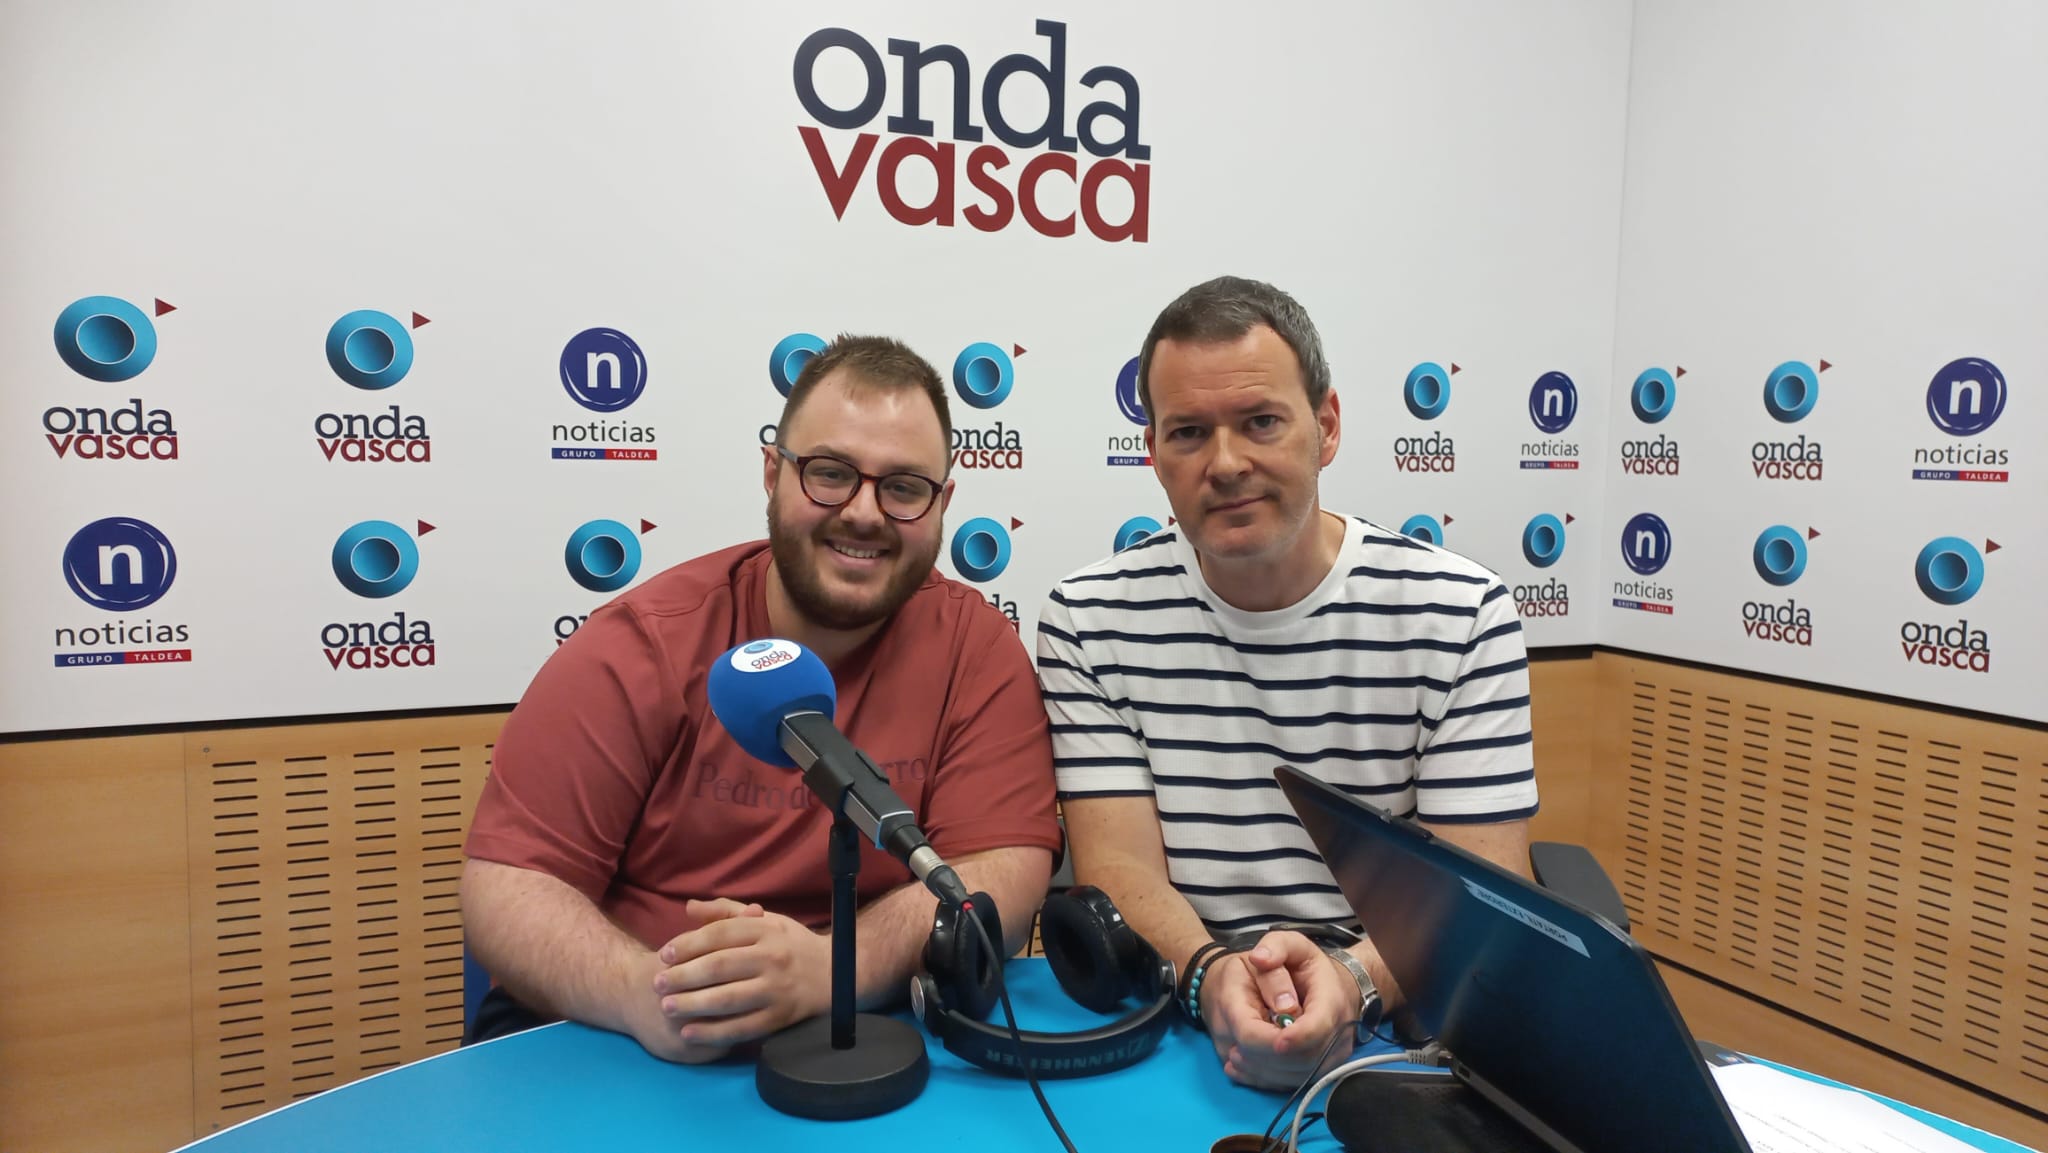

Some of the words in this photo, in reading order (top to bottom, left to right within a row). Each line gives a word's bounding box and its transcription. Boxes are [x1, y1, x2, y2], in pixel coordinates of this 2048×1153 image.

[793, 19, 1151, 161] onda
[797, 126, 1151, 243] vasca
[587, 351, 622, 389] n
[1542, 388, 1564, 416] n
[1949, 379, 1982, 415] n
[43, 398, 177, 437] onda
[315, 405, 431, 440] onda
[552, 420, 656, 444] noticias
[1393, 431, 1456, 456] onda
[46, 433, 179, 460] vasca
[317, 438, 431, 463] vasca
[561, 450, 596, 458] GRUPO
[1520, 440, 1579, 457] noticias
[1621, 434, 1680, 460] onda
[1752, 435, 1823, 463] onda
[1914, 444, 2009, 465] noticias
[1394, 455, 1456, 473] vasca
[1622, 457, 1680, 476] vasca
[1752, 460, 1823, 481] vasca
[1635, 529, 1656, 559] n
[99, 543, 144, 585] n
[1513, 577, 1569, 603] onda
[1613, 580, 1674, 601] noticias
[1515, 600, 1569, 617] vasca
[1742, 599, 1813, 628] onda
[55, 619, 190, 647] noticias
[321, 612, 435, 649] onda
[1743, 620, 1813, 647] vasca
[1901, 619, 1990, 653] onda
[67, 655, 112, 664] GRUPO
[134, 652, 183, 662] TALDEA
[323, 643, 436, 671] vasca
[750, 650, 788, 666] onda
[754, 653, 793, 670] vasca
[1902, 641, 1990, 673] vasca
[690, 763, 785, 809] Pedro
